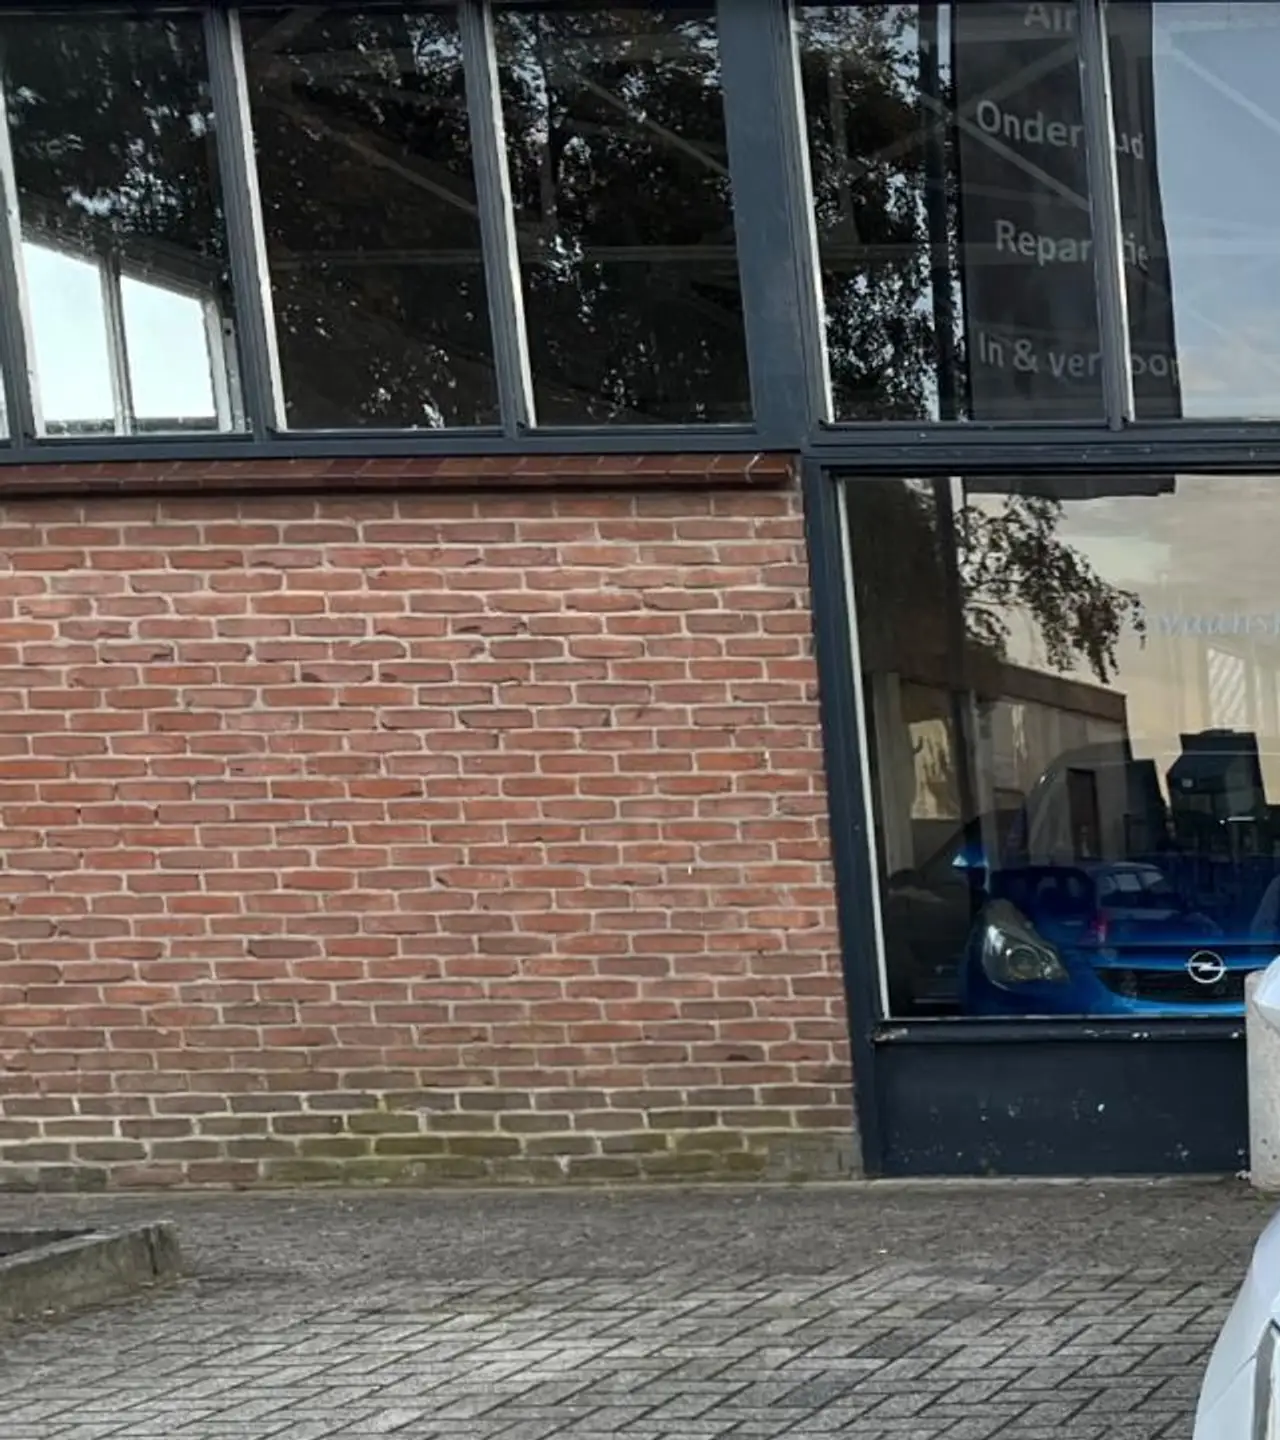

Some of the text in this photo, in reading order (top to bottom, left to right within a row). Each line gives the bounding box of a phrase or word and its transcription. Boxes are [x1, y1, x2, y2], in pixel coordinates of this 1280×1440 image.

[976, 99, 1144, 161] Onderud
[994, 217, 1149, 272] Reparie
[977, 330, 1182, 387] In & veroop
